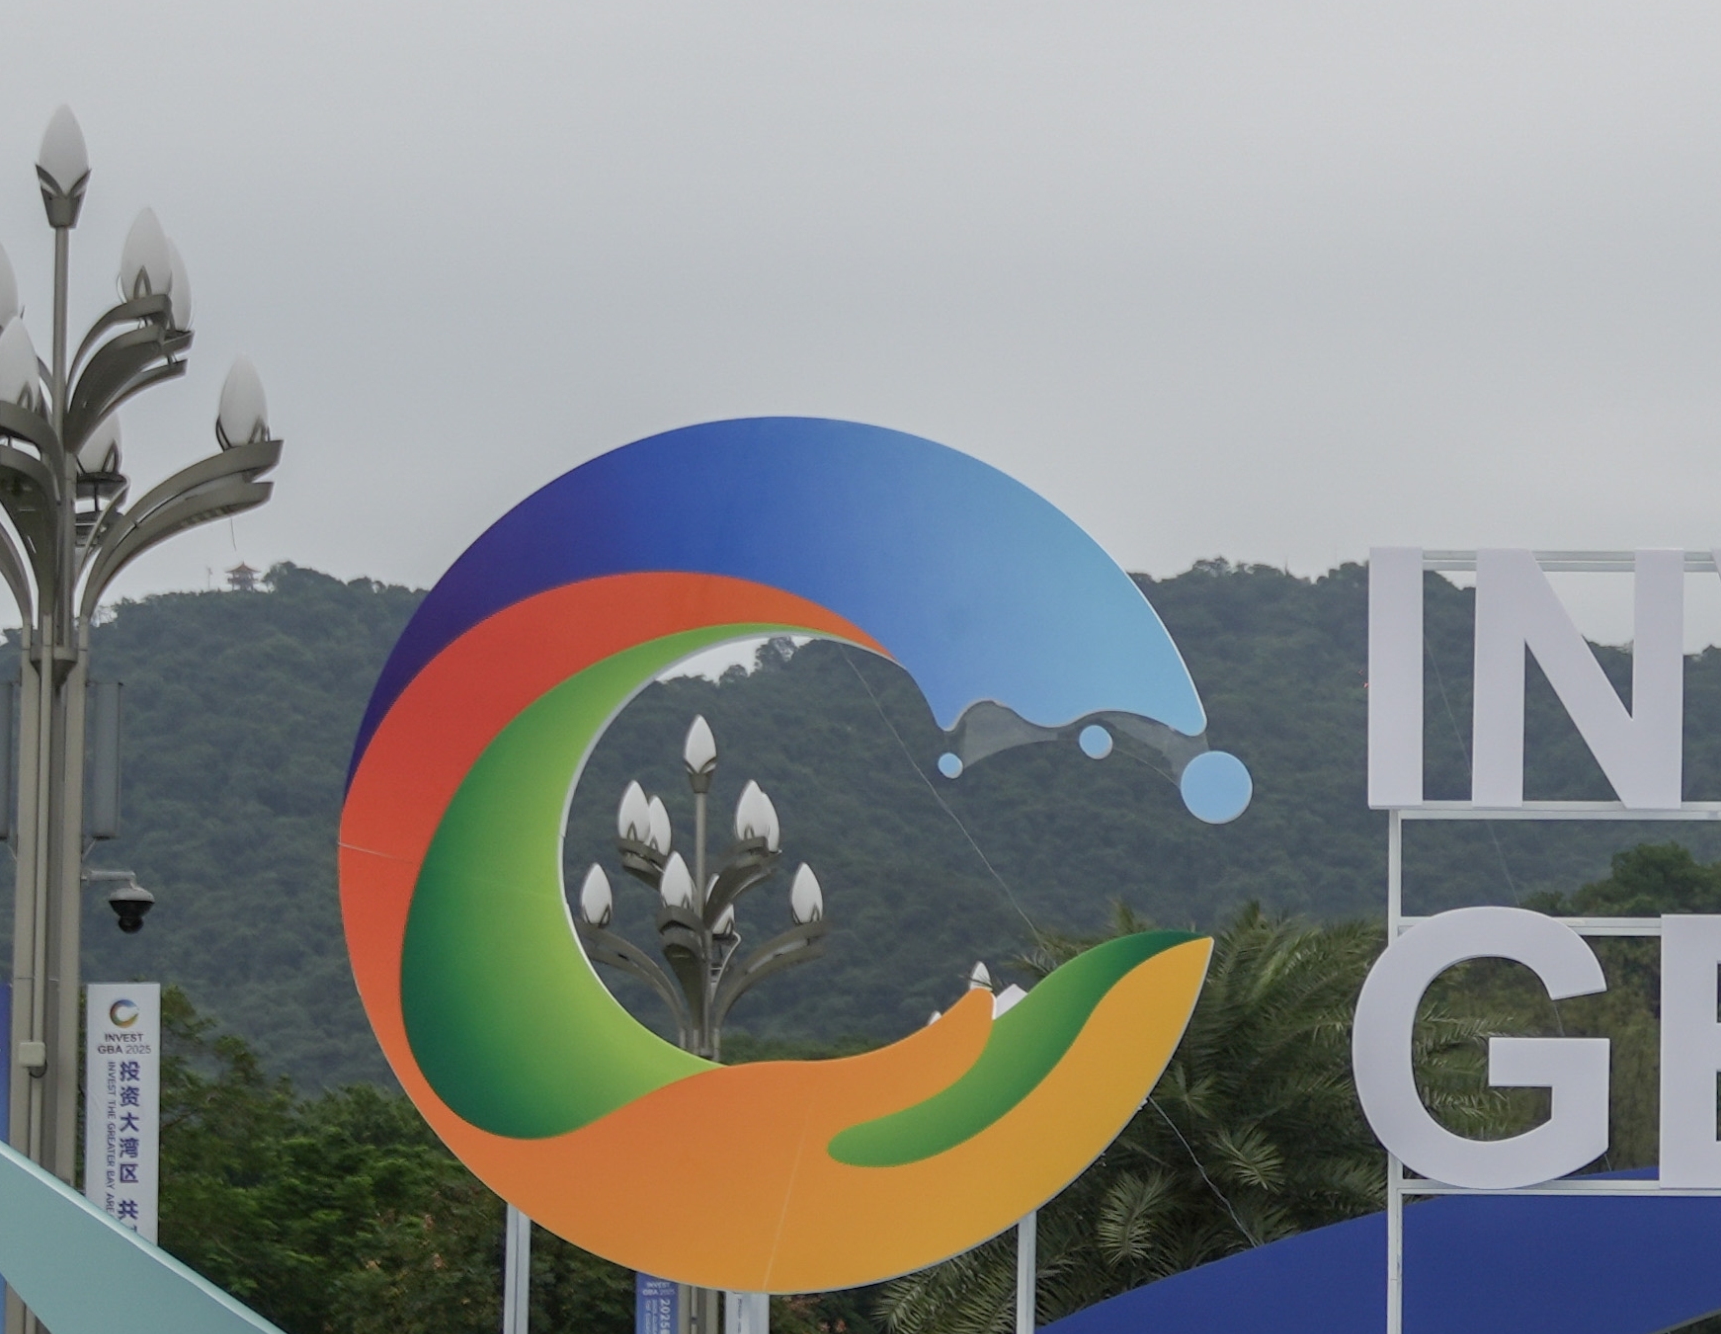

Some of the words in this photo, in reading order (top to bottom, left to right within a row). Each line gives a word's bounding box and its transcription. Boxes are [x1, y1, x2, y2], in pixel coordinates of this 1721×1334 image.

[104, 1033, 144, 1043] INVEST
[98, 1045, 123, 1055] GBA
[125, 1045, 151, 1055] 2025
[107, 1061, 116, 1097] INVEST
[107, 1100, 116, 1119] THE
[119, 1060, 140, 1184] 投资大湾区
[106, 1123, 116, 1167] GREATER
[106, 1170, 115, 1190] BAY
